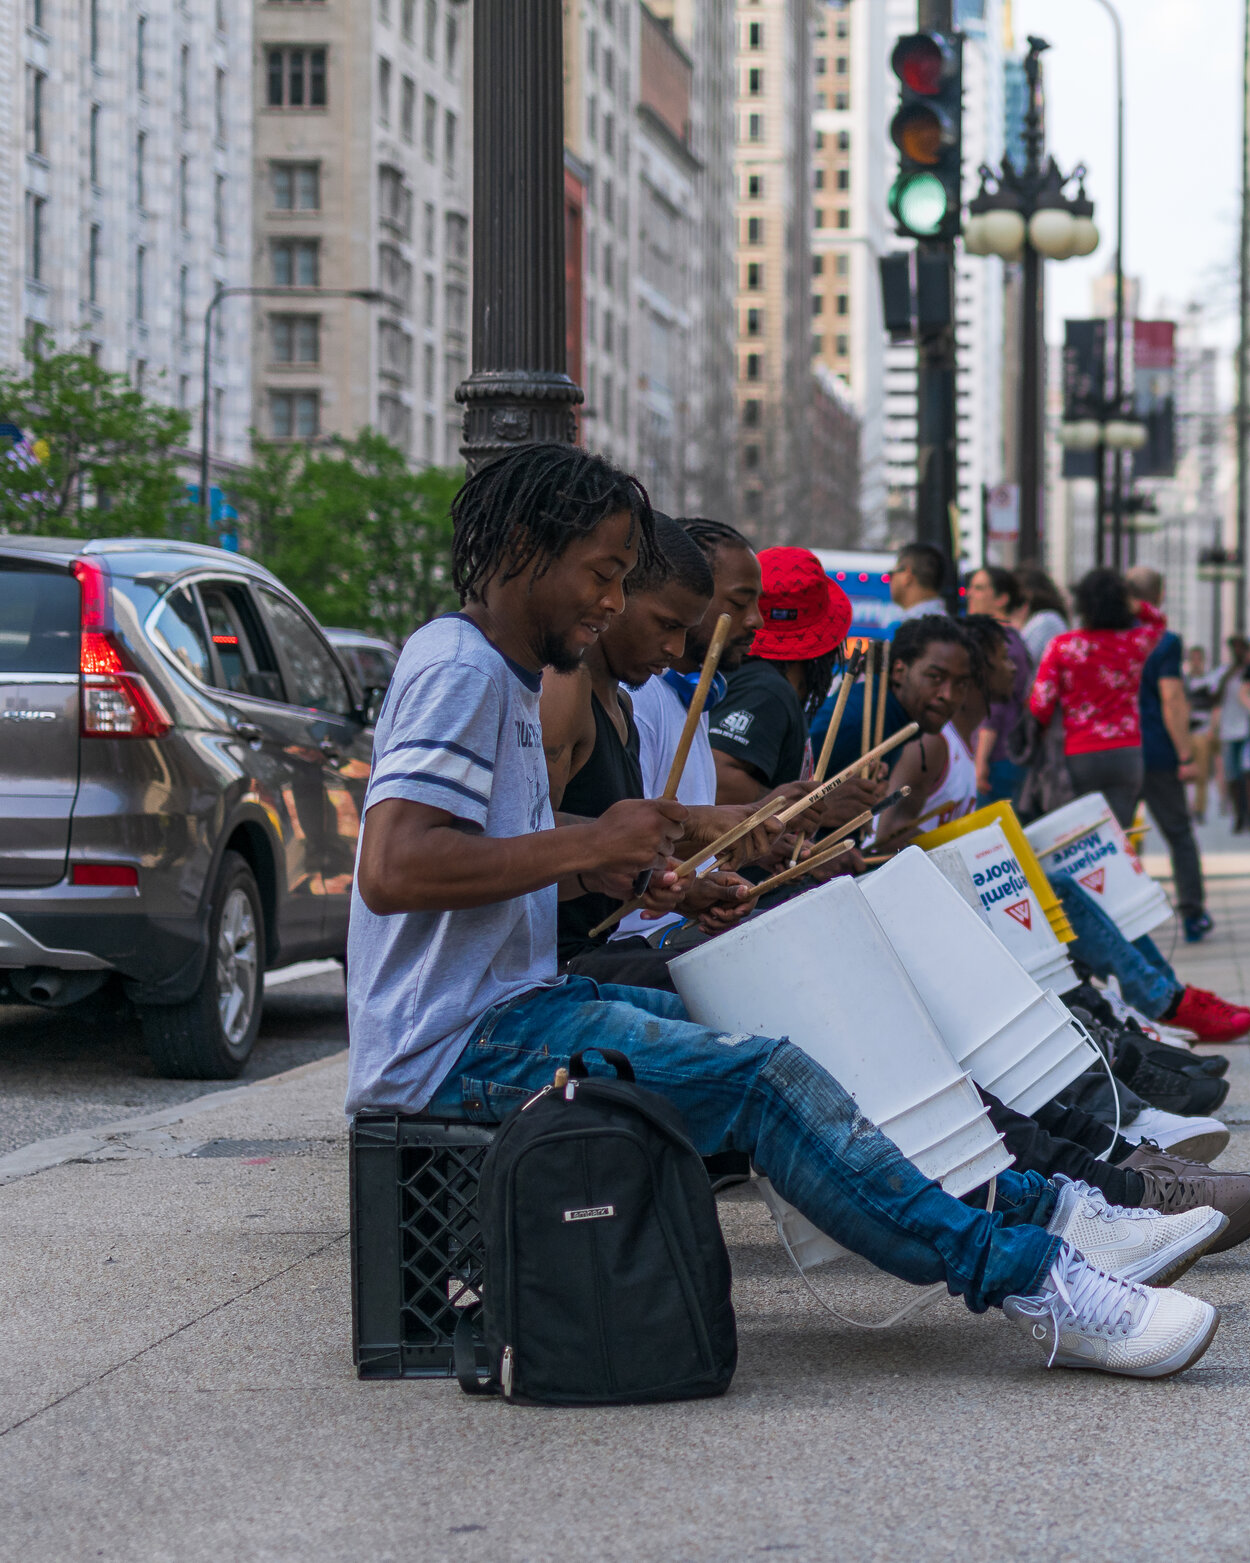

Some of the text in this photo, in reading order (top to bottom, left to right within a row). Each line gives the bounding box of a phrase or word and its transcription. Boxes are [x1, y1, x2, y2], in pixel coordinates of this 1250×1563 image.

[1052, 831, 1102, 864] Moore
[1062, 841, 1118, 875] Benjam
[972, 857, 1021, 887] Moore
[979, 875, 1029, 911] enjami
